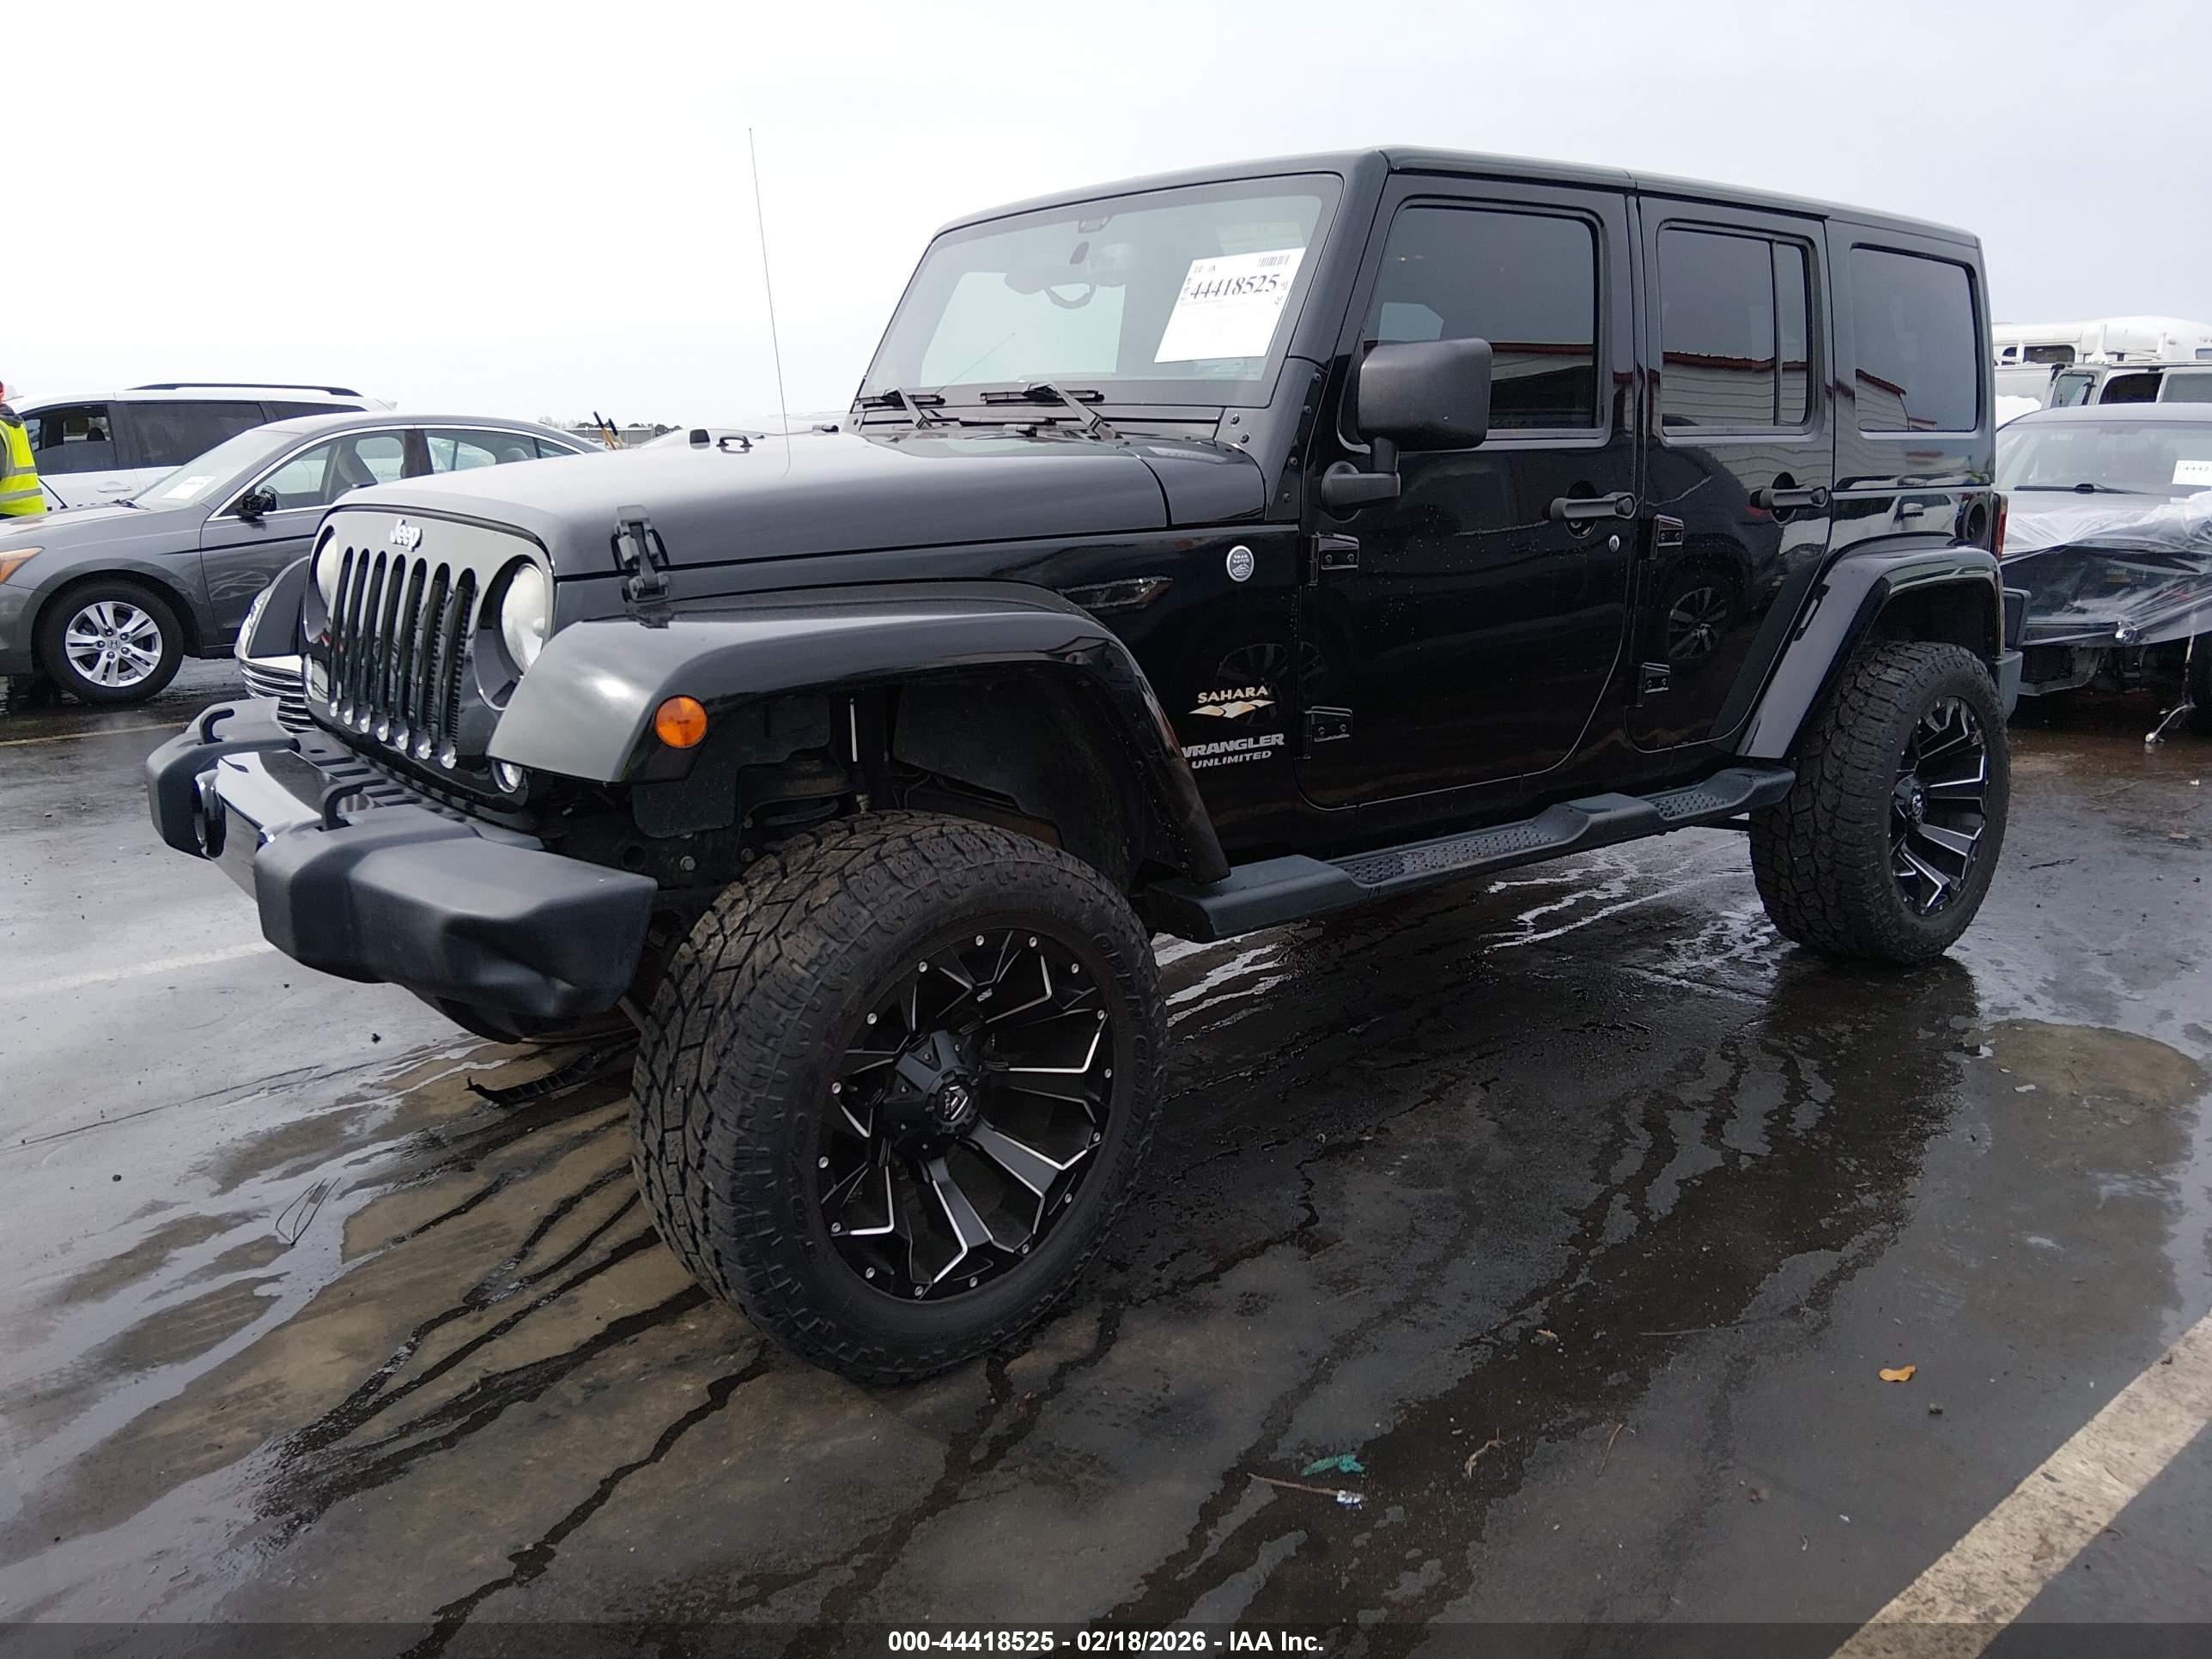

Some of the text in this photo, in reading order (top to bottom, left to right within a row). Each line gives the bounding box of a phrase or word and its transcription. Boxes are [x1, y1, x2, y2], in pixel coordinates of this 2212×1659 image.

[1190, 274, 1280, 300] 44418525
[390, 519, 422, 552] Jeep
[1197, 685, 1269, 703] SAHARA
[1191, 750, 1273, 769] UNLIMITED
